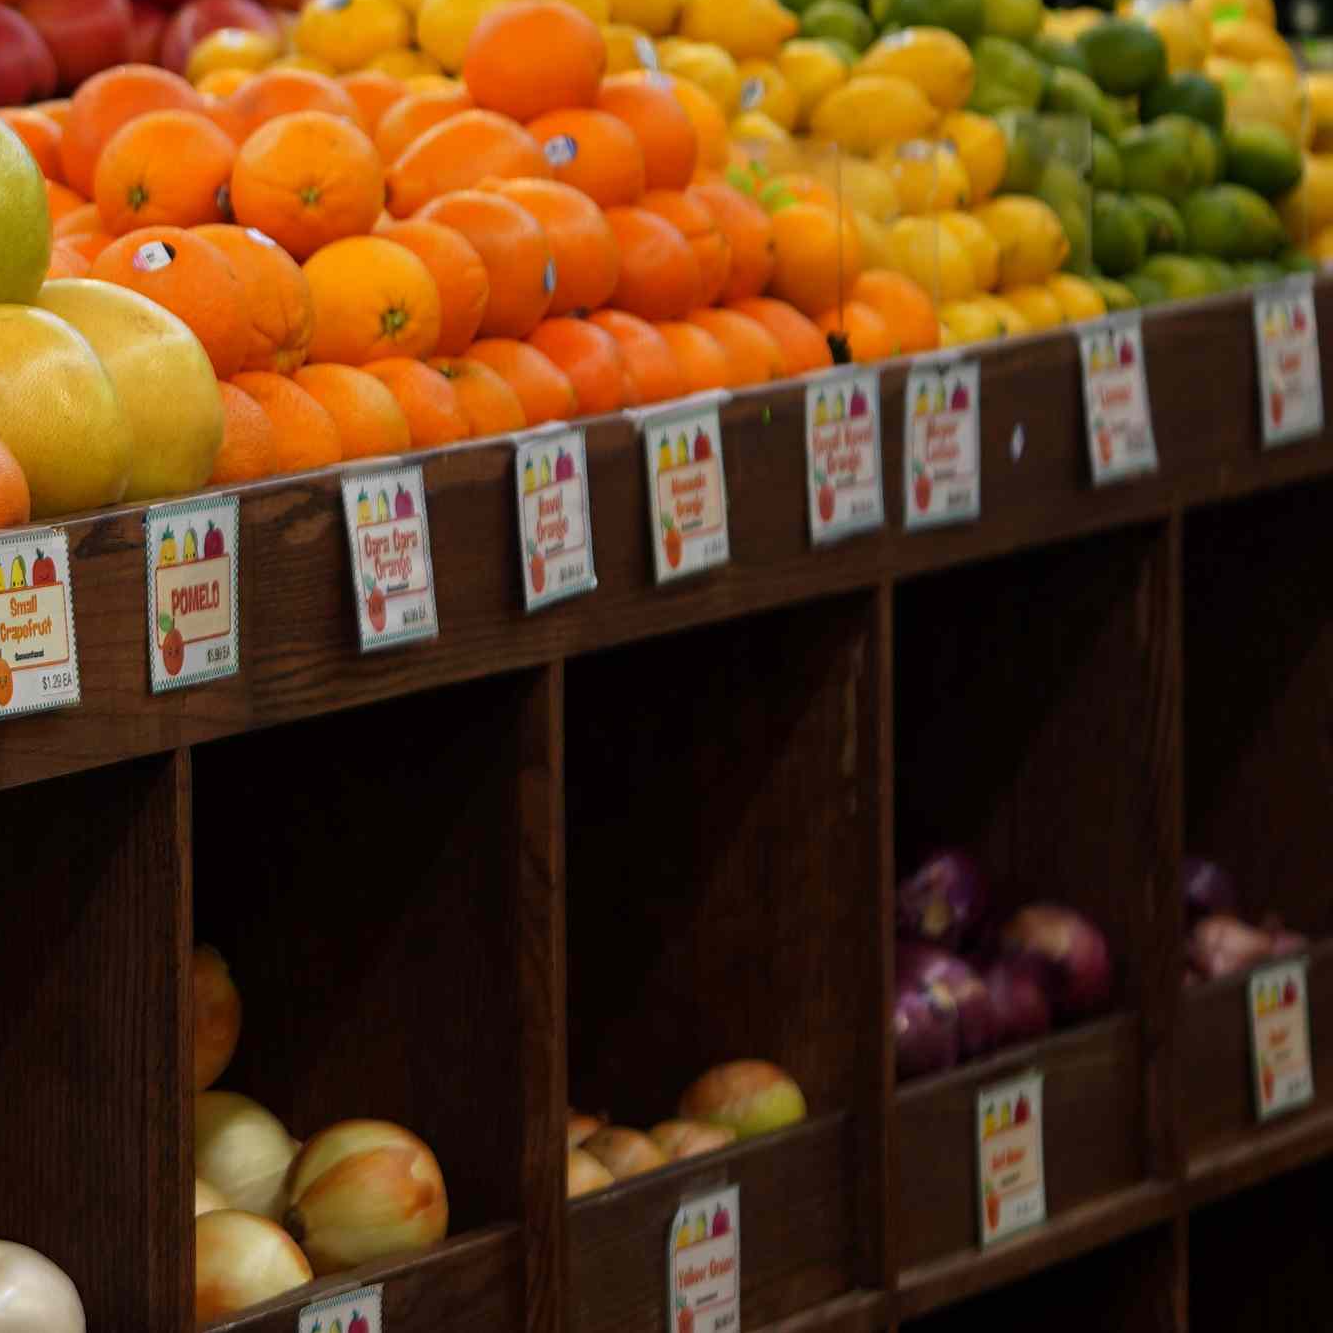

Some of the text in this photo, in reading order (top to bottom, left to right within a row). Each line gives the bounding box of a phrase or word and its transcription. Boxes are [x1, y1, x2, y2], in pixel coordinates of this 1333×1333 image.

[9, 594, 37, 618] Small
[171, 579, 220, 617] POMELO
[0, 615, 53, 644] Grapefruit
[62, 671, 73, 687] EA
